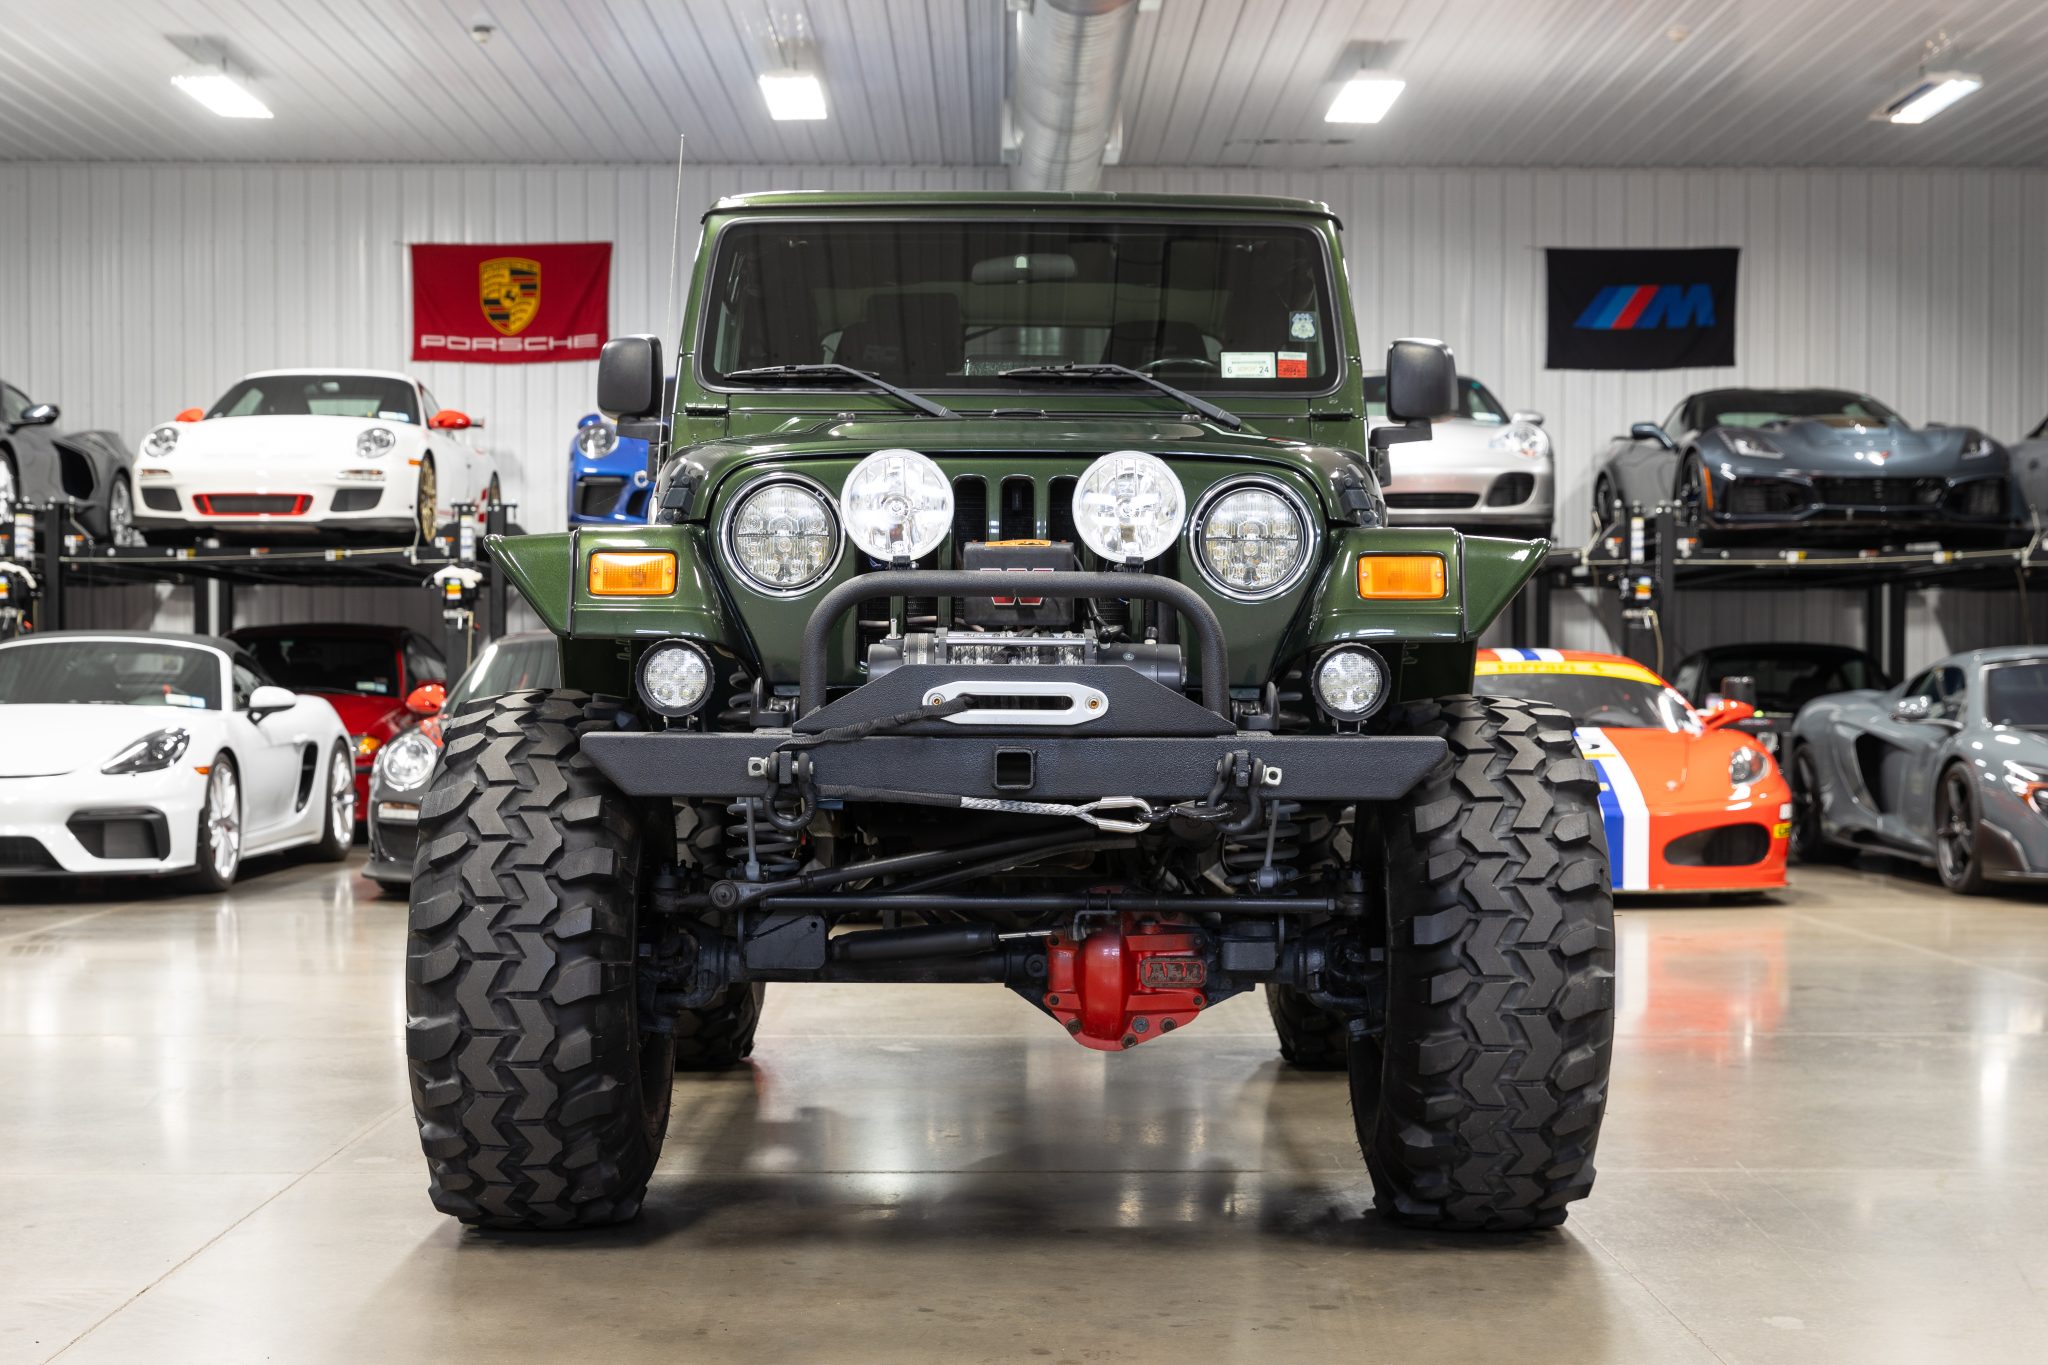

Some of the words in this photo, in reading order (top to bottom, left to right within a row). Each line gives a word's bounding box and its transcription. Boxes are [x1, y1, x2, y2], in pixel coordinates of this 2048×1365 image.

[421, 333, 598, 352] PORSCHE
[1227, 366, 1233, 374] 6
[1259, 366, 1270, 374] 24
